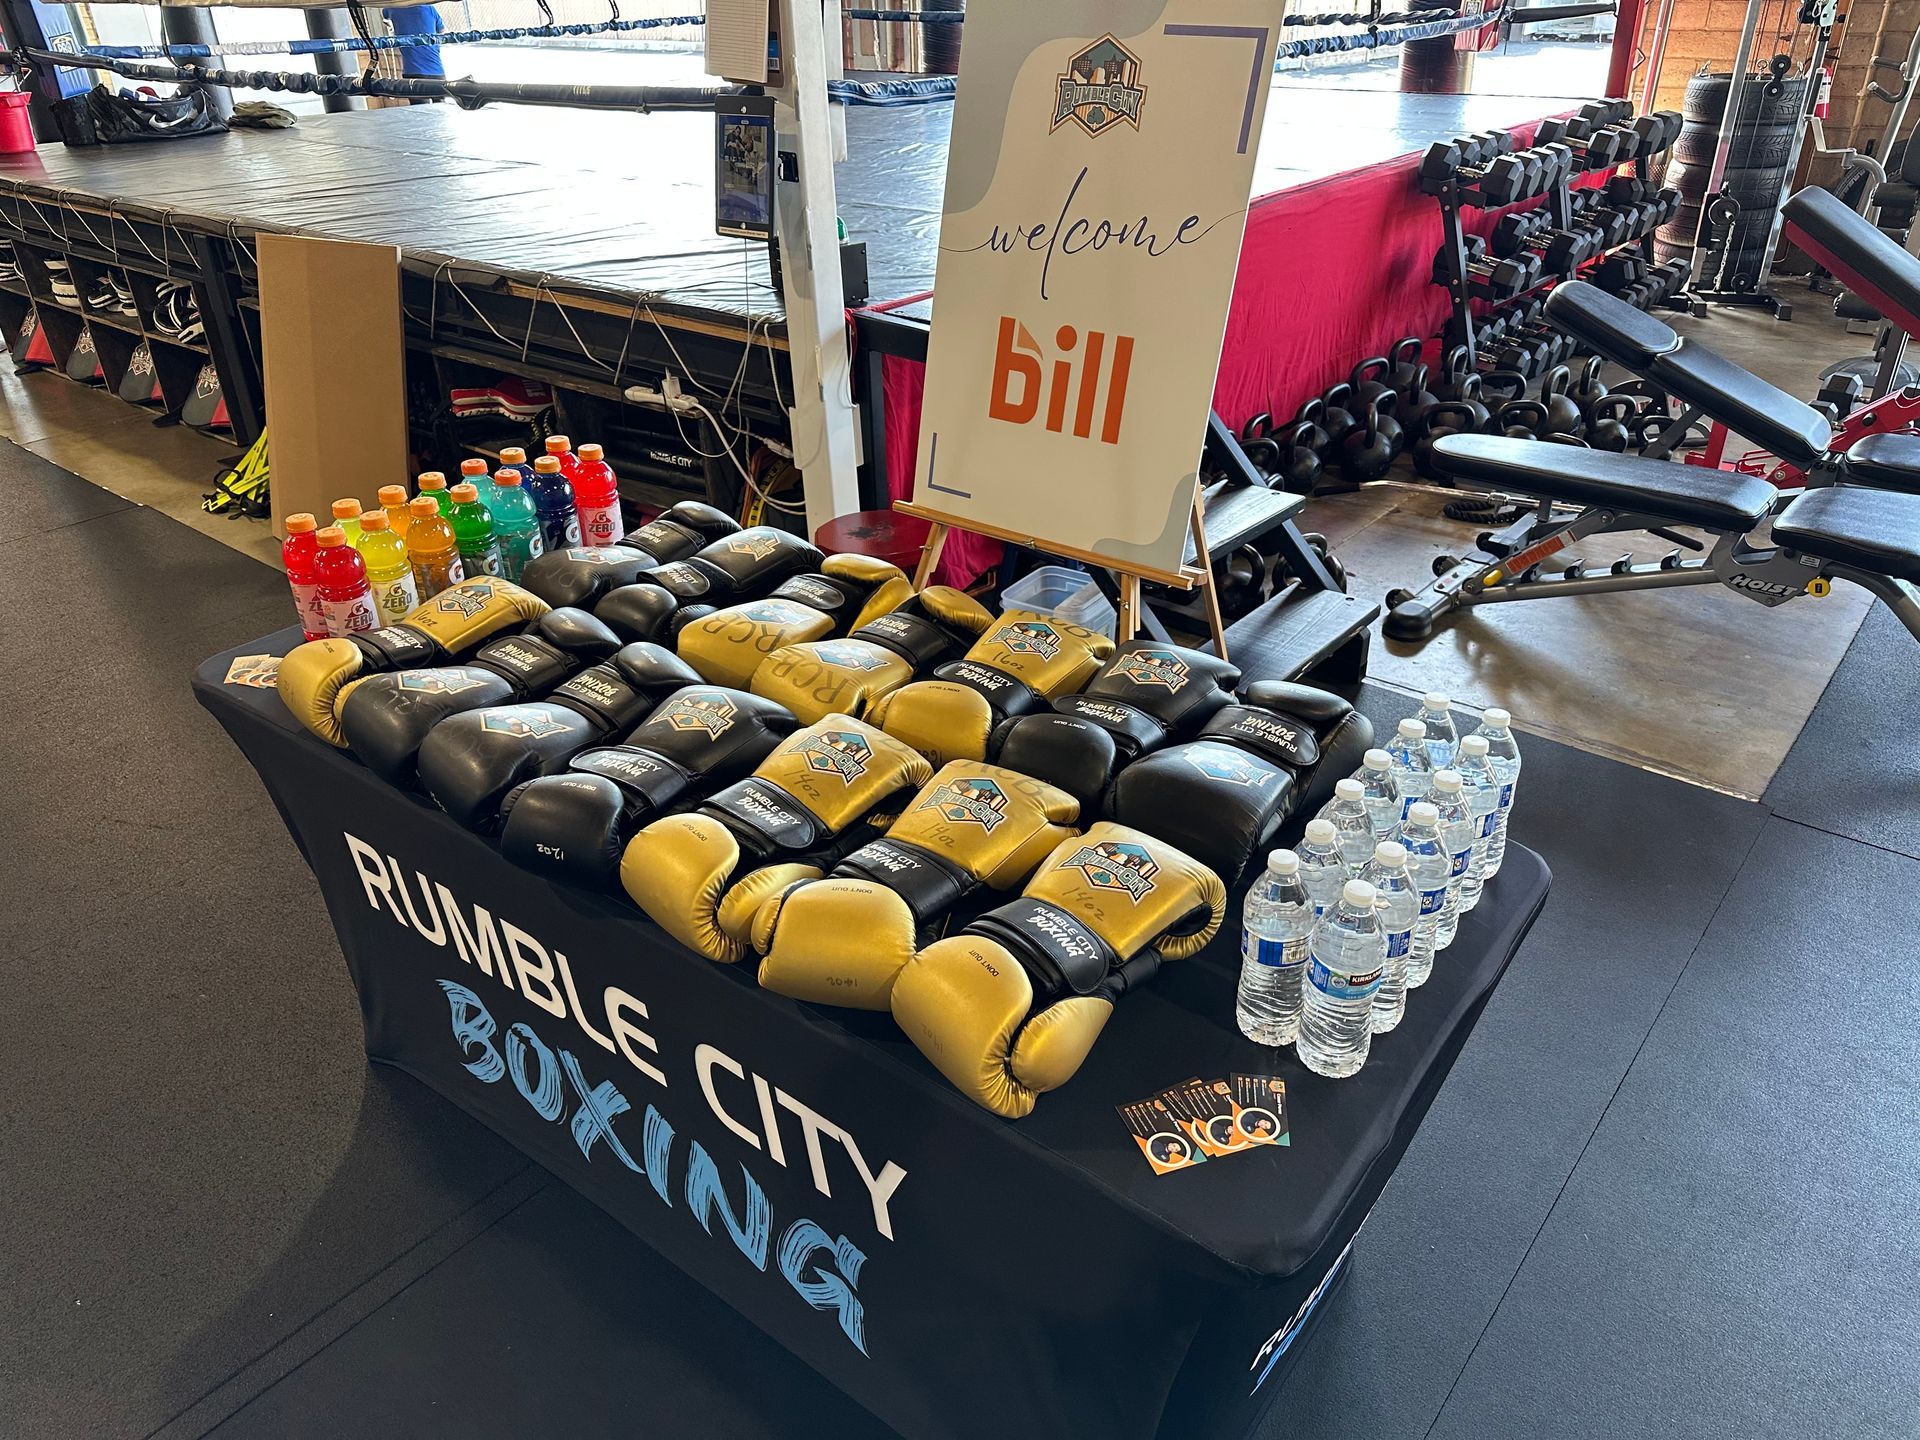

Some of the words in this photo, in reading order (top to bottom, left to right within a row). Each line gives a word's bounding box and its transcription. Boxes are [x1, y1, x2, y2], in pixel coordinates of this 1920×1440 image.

[975, 167, 1215, 300] welcome
[988, 315, 1135, 445] bill
[588, 522, 616, 533] ZERO
[1730, 573, 1798, 596] HOIST
[382, 592, 412, 610] ZERO
[344, 610, 374, 629] ZERO
[991, 651, 1025, 672] 16oz
[574, 673, 619, 697] BOXING
[955, 668, 1003, 691] BOXING
[958, 662, 994, 678] RUMBLE
[993, 673, 1014, 687] CITY
[562, 681, 583, 693] CITY
[579, 686, 614, 706] RUMBLE
[1075, 705, 1128, 724] BOXING
[1076, 700, 1117, 713] RUMBLE
[1115, 707, 1139, 719] CITY
[1230, 722, 1256, 735] CITY
[1242, 716, 1297, 742] BOXING
[1254, 729, 1298, 754] RUMBLE
[592, 757, 649, 777] BOXING
[637, 759, 662, 773] CITY
[561, 780, 577, 788] QUIT
[577, 782, 598, 791] DON'T
[784, 769, 822, 801] 14oz
[735, 796, 788, 827] BOXING
[743, 787, 781, 818] RUMBLE
[778, 810, 801, 826] CITY
[920, 822, 957, 849] 14oz
[897, 855, 922, 870] CITY
[1062, 886, 1106, 923] 14oz
[1026, 915, 1086, 958] BOXING
[1033, 906, 1079, 937] RUMBLE
[1075, 934, 1099, 961] CITY
[967, 948, 984, 963] QUIT
[981, 959, 1000, 978] DON'T
[343, 831, 668, 1088] RUMBLE
[693, 1042, 909, 1243] CITY
[434, 977, 872, 1360] BOXING
